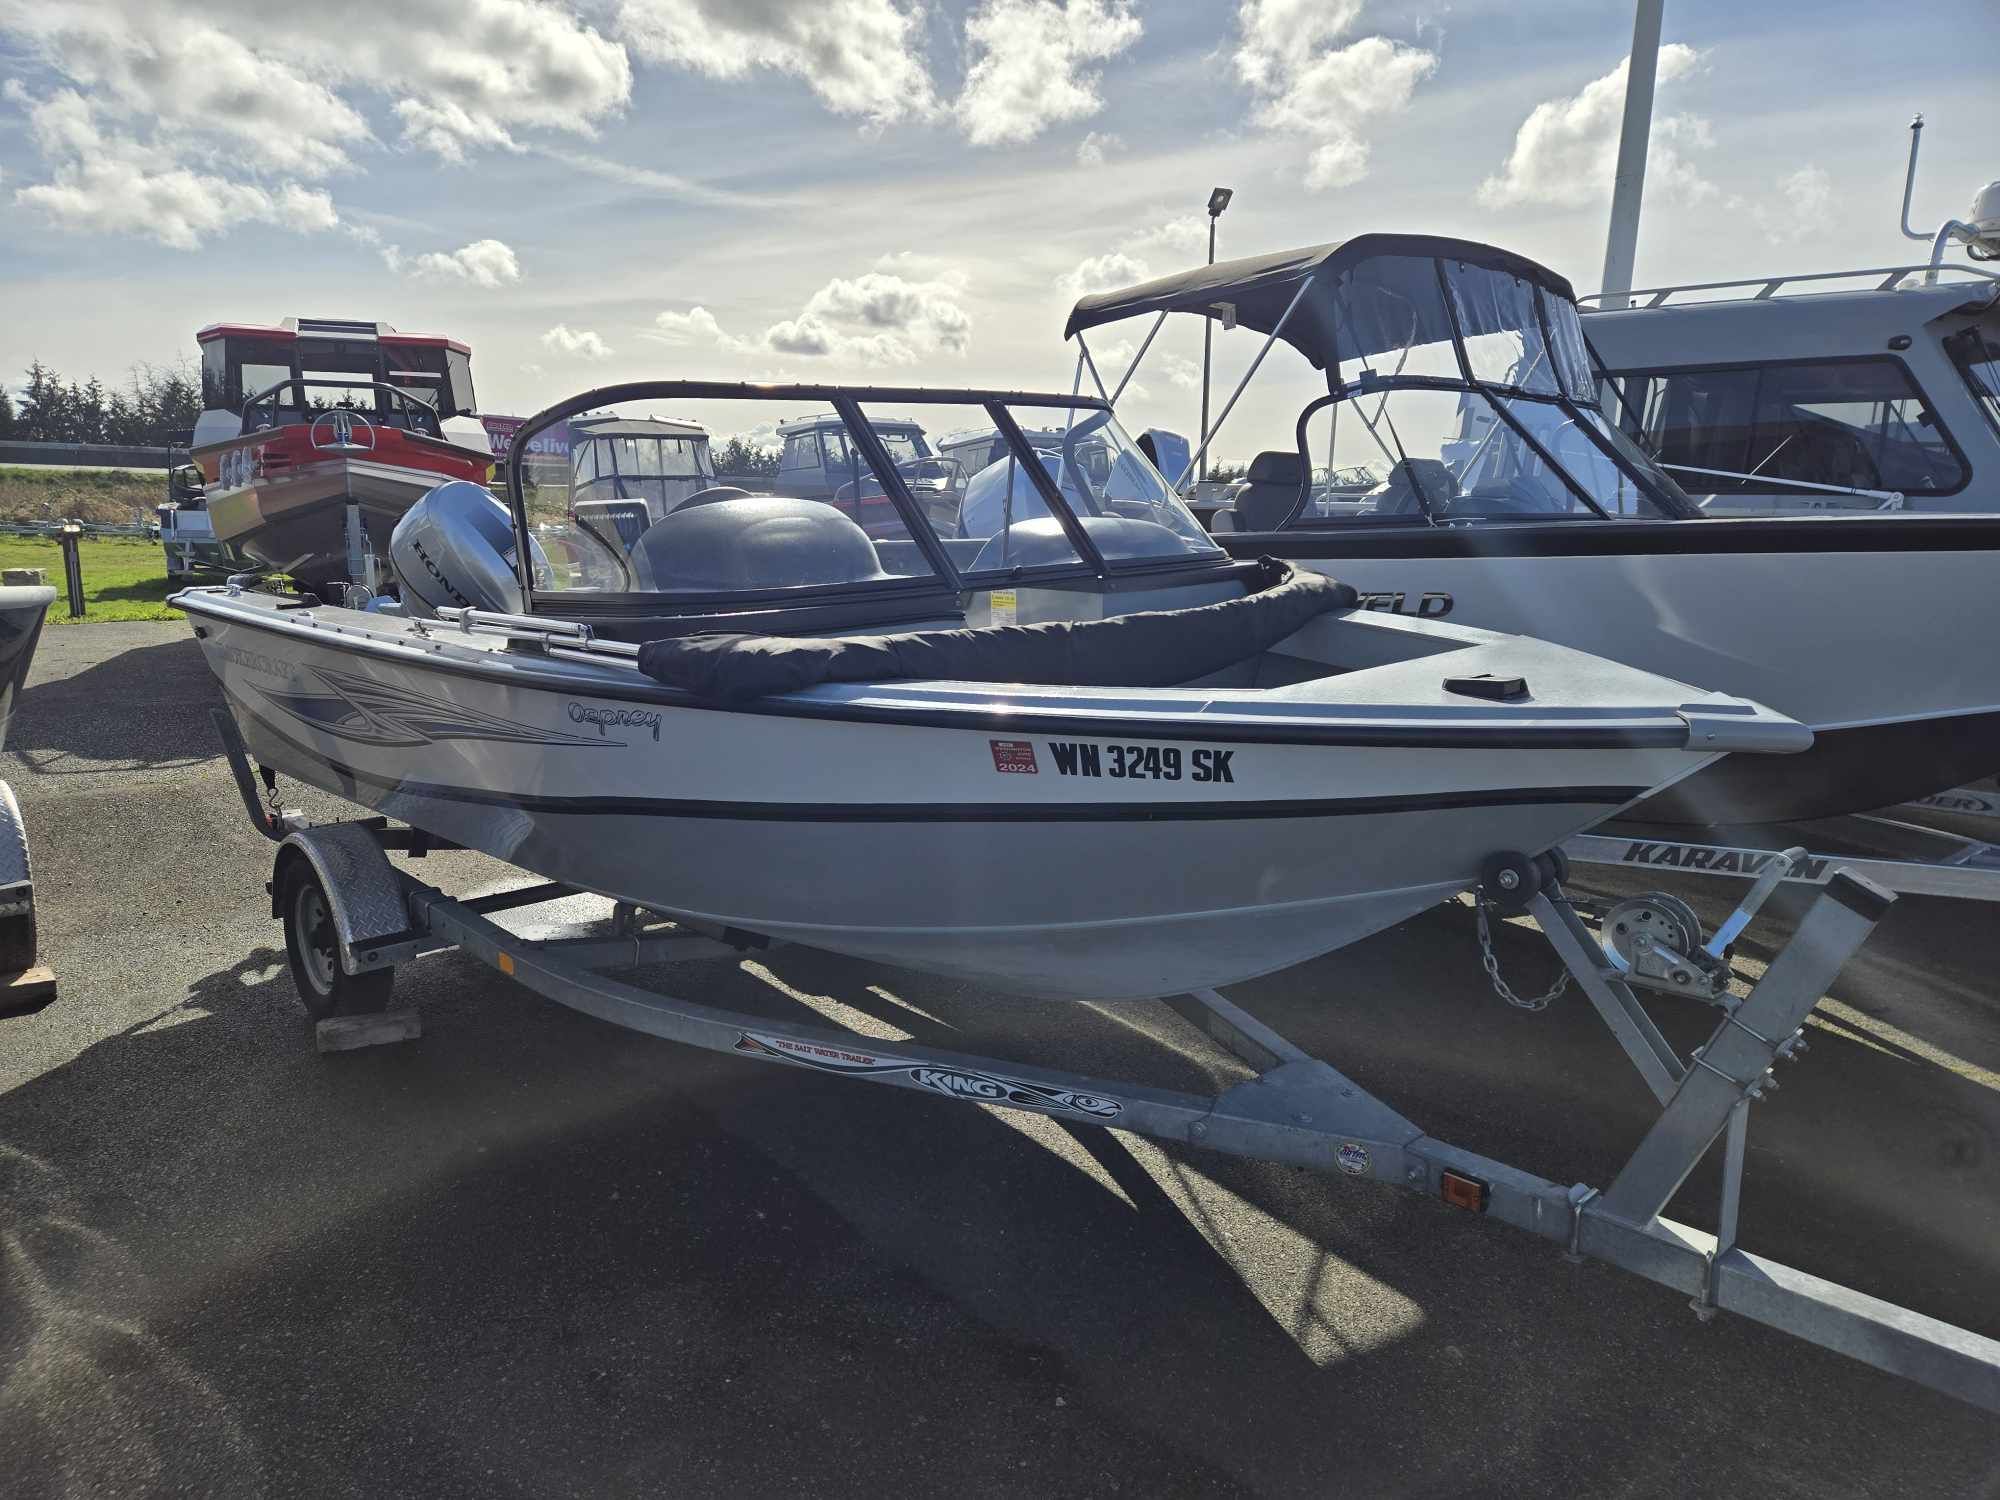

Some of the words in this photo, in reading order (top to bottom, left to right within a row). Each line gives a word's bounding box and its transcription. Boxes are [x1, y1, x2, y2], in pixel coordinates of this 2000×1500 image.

[413, 540, 472, 609] HOND
[568, 702, 661, 741] Osprey
[1000, 763, 1036, 772] 2024
[1048, 742, 1102, 778] WN
[1107, 745, 1182, 781] 3249
[1192, 749, 1235, 783] SK
[794, 1043, 813, 1053] SALT
[814, 1047, 840, 1059] WATER
[920, 1069, 997, 1097] KING
